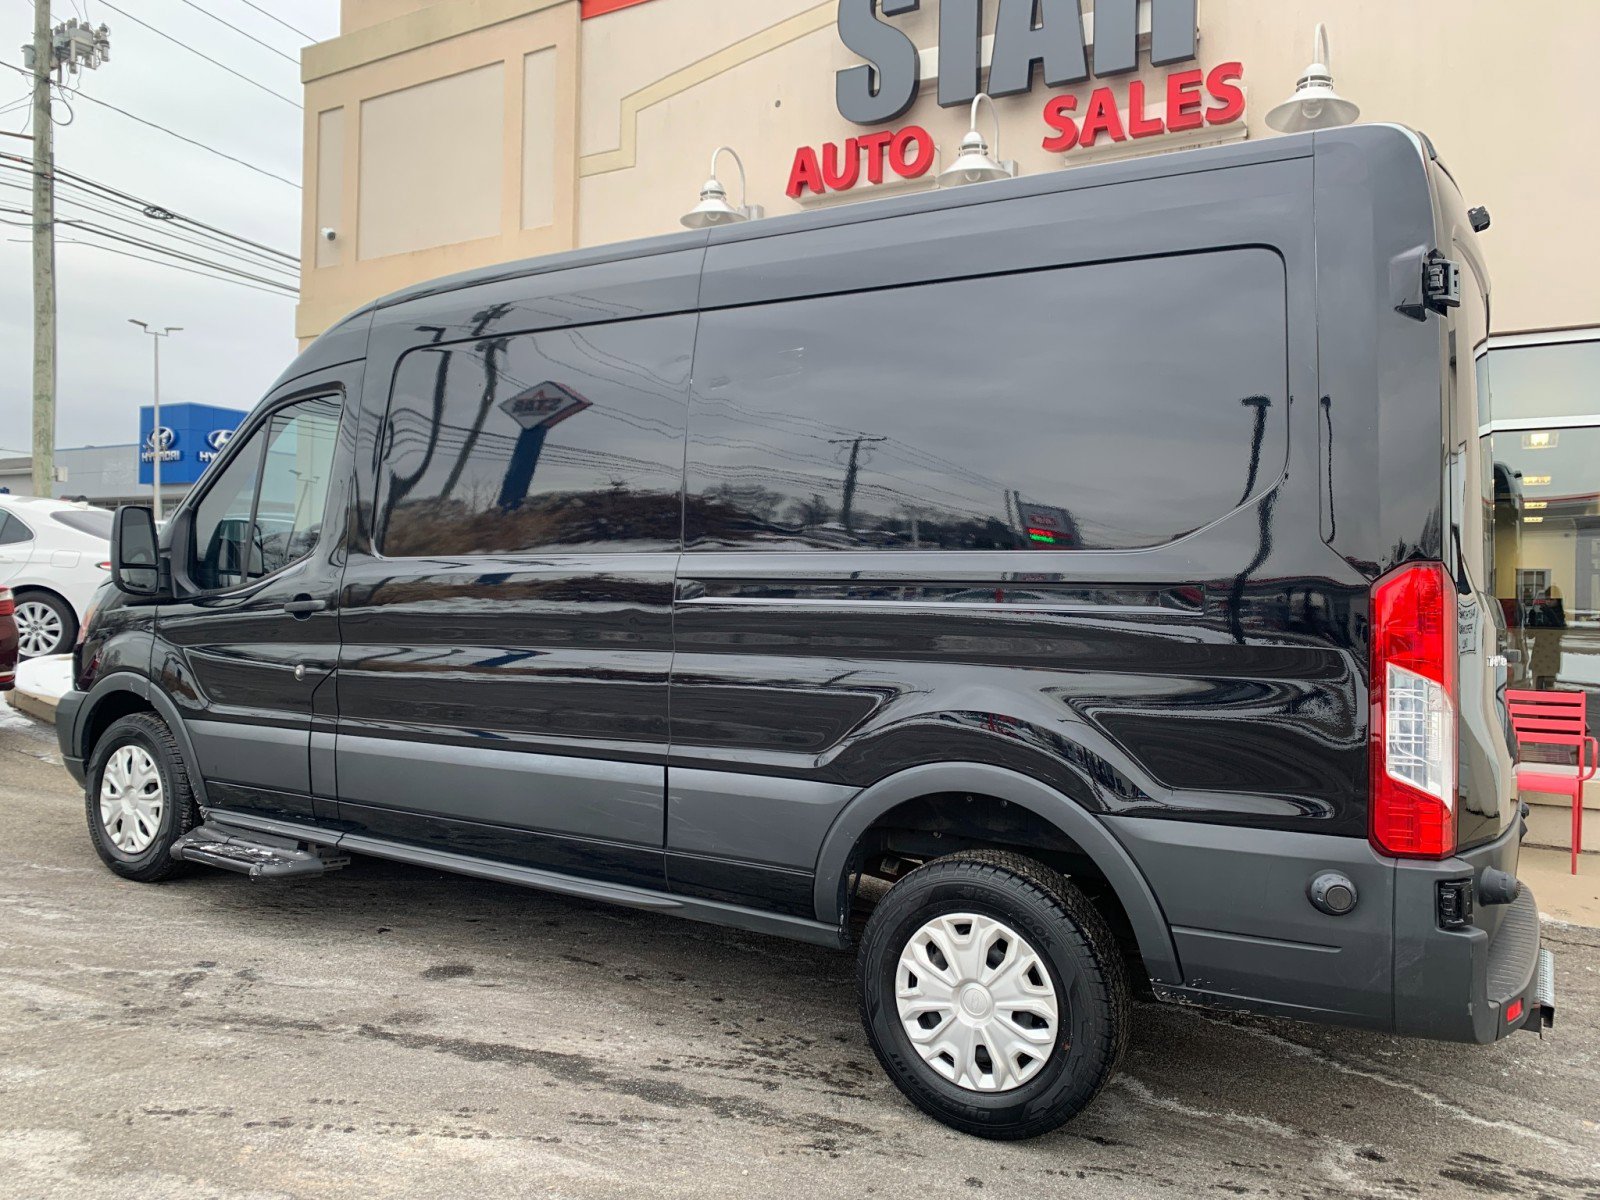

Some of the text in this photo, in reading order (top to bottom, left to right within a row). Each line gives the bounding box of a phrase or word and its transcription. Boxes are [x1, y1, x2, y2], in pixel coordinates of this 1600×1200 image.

[785, 62, 1244, 198] AUTO SALES
[141, 449, 181, 462] HYNDAI
